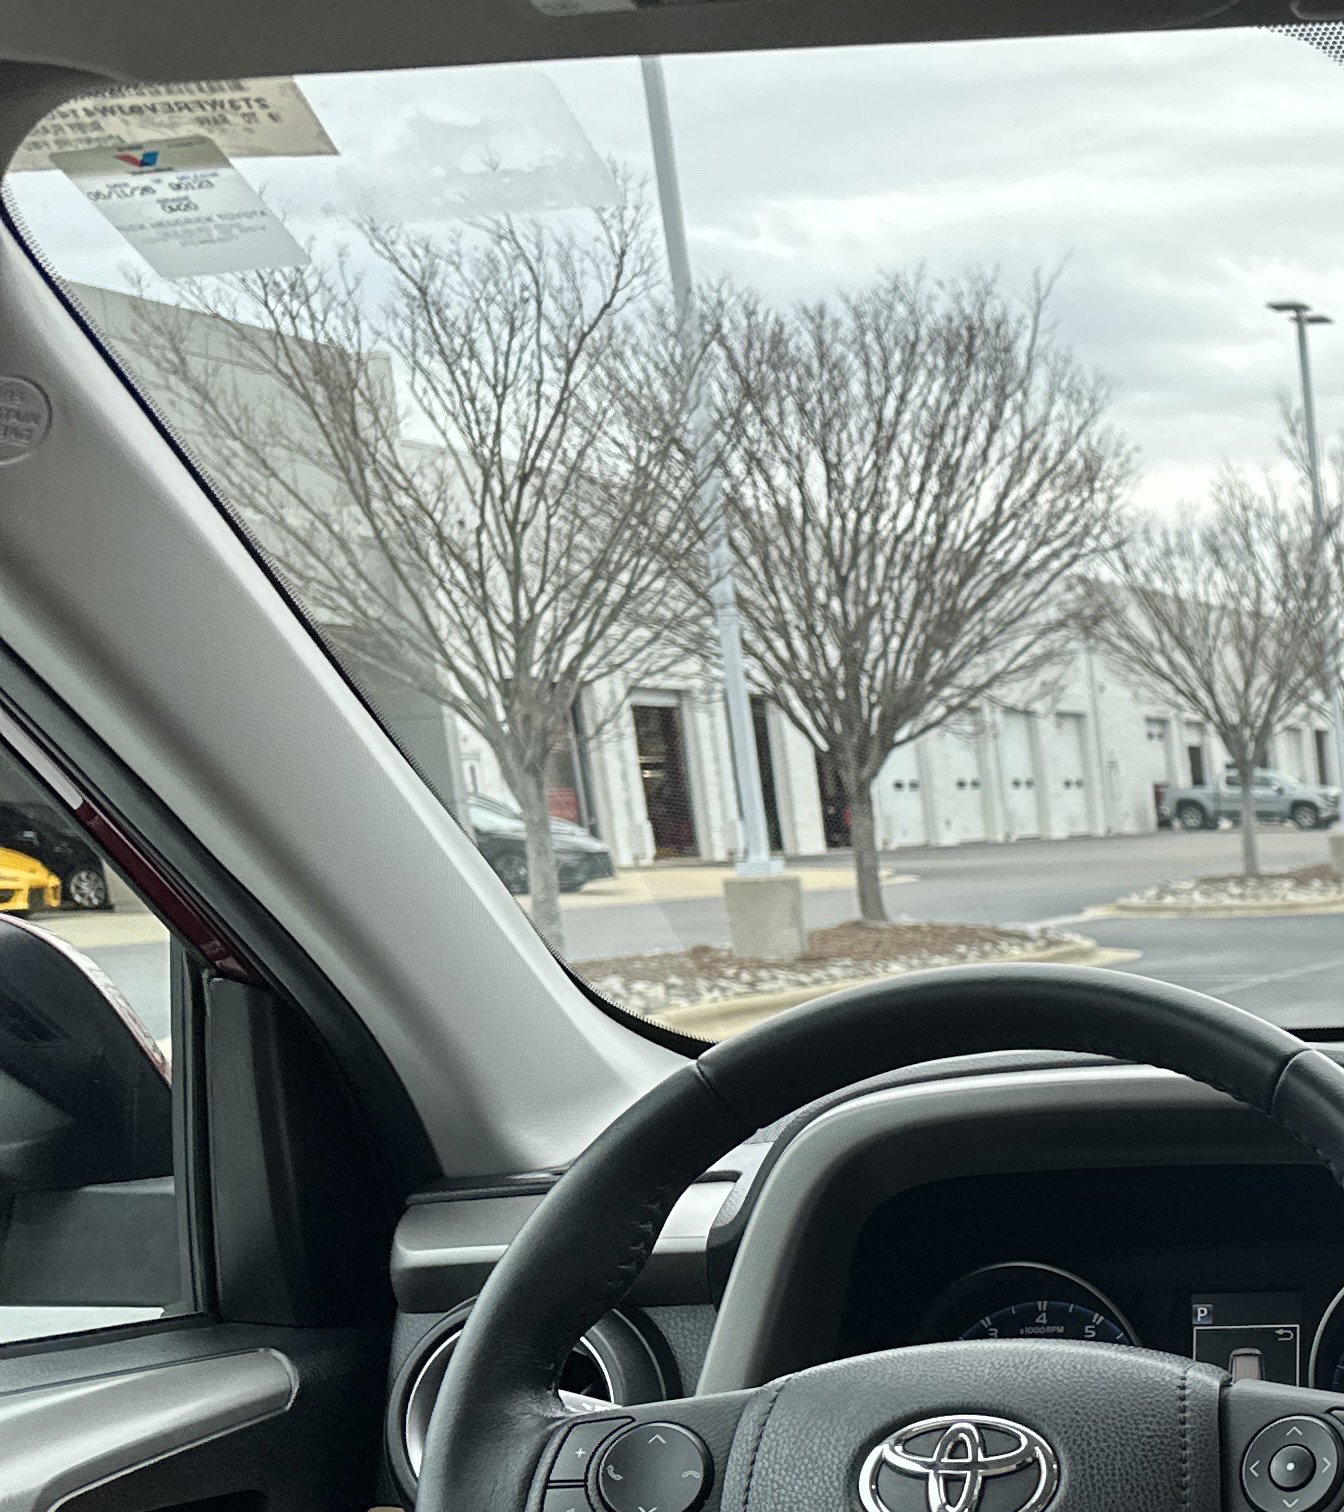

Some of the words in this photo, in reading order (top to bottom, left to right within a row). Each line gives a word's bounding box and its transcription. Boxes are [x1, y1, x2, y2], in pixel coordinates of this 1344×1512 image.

[1034, 1312, 1049, 1325] 4
[1196, 1306, 1209, 1321] P
[1084, 1325, 1096, 1338] 5
